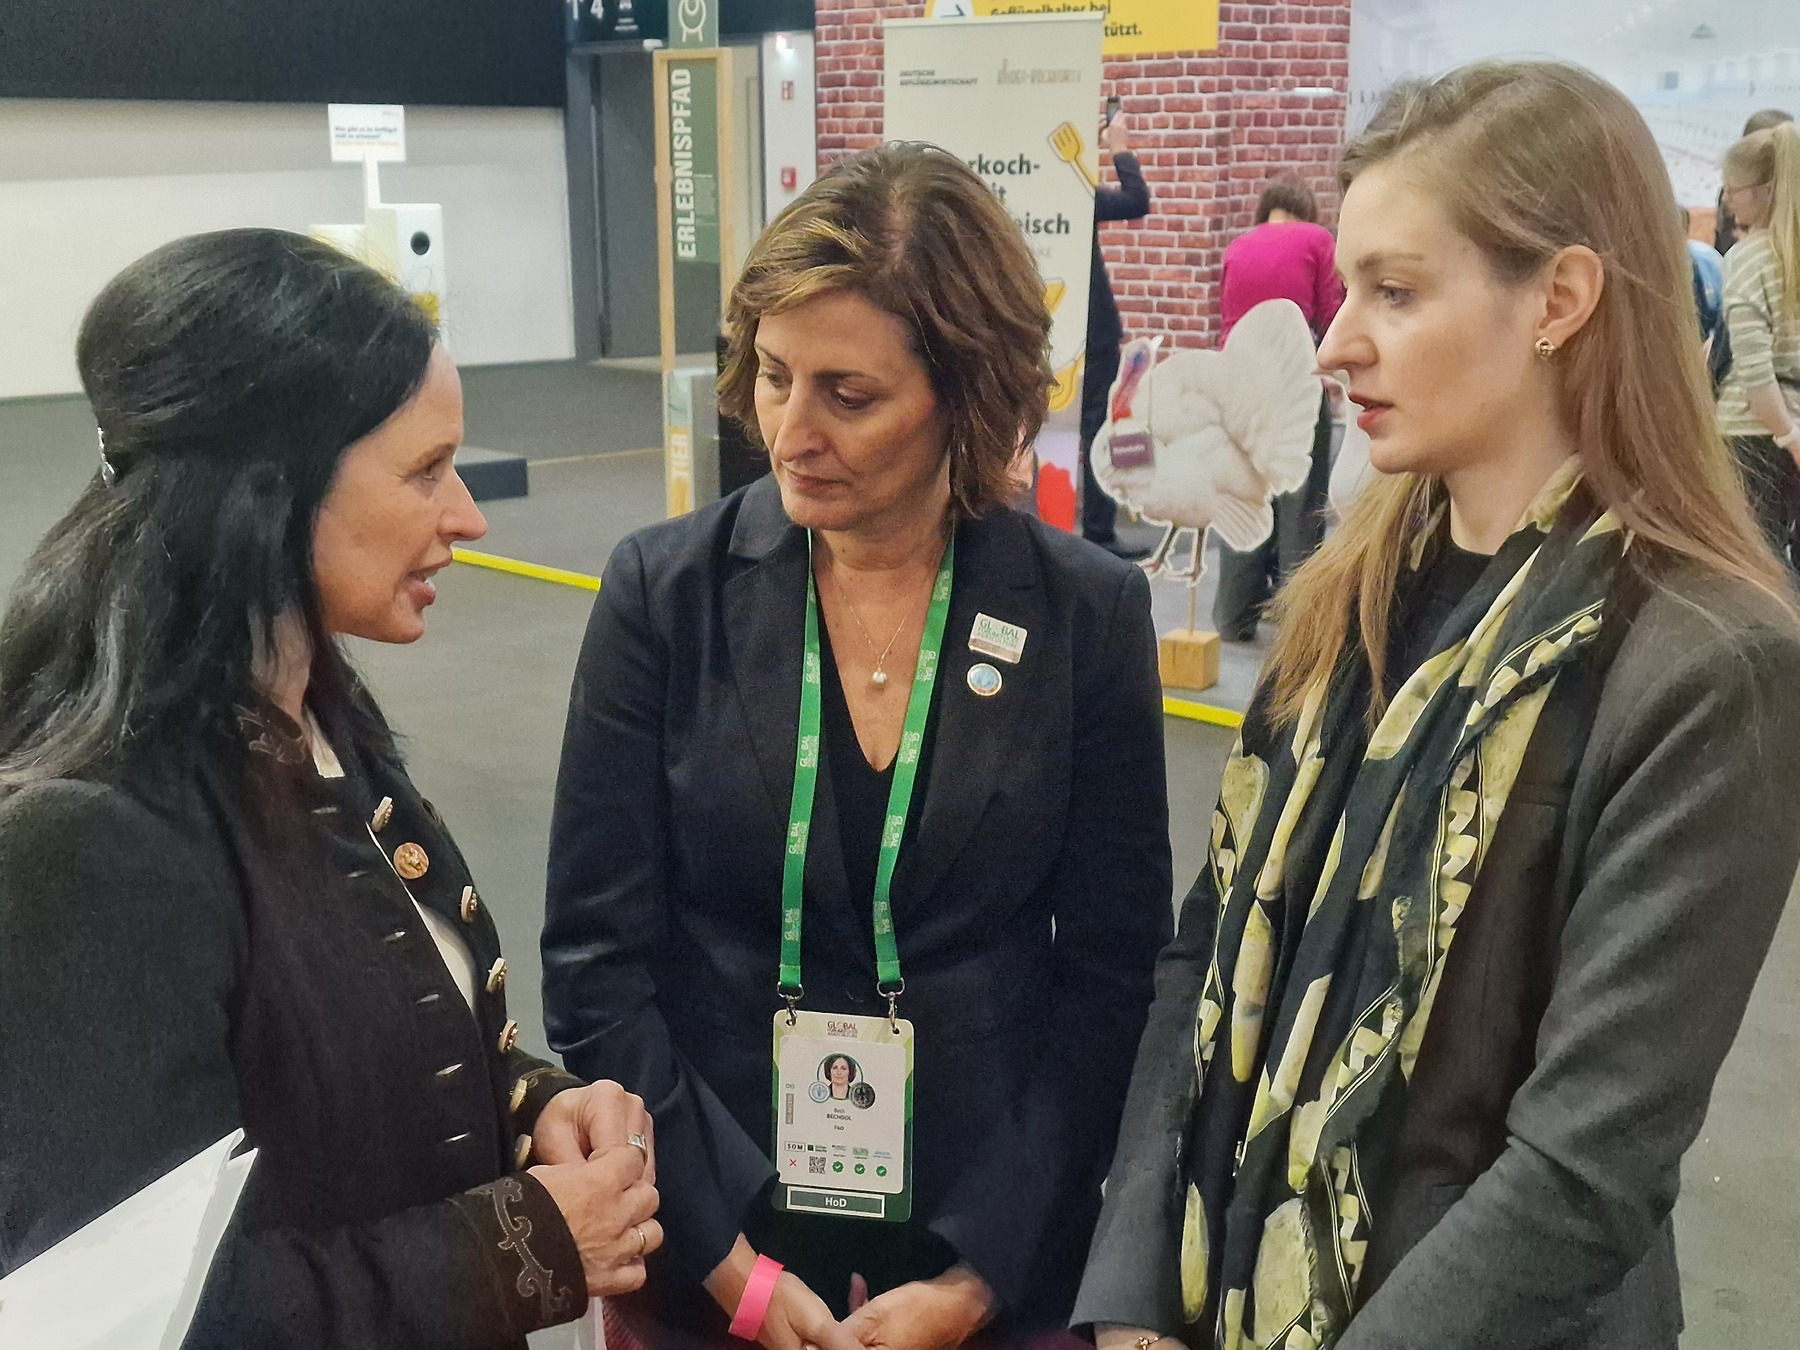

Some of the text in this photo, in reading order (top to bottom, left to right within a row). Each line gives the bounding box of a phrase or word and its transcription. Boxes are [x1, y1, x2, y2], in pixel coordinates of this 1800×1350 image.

[671, 68, 697, 258] ERLEBNISPFAD
[981, 619, 1019, 639] GLBAL
[828, 1021, 856, 1030] GLBAL
[825, 1197, 847, 1207] HoD
